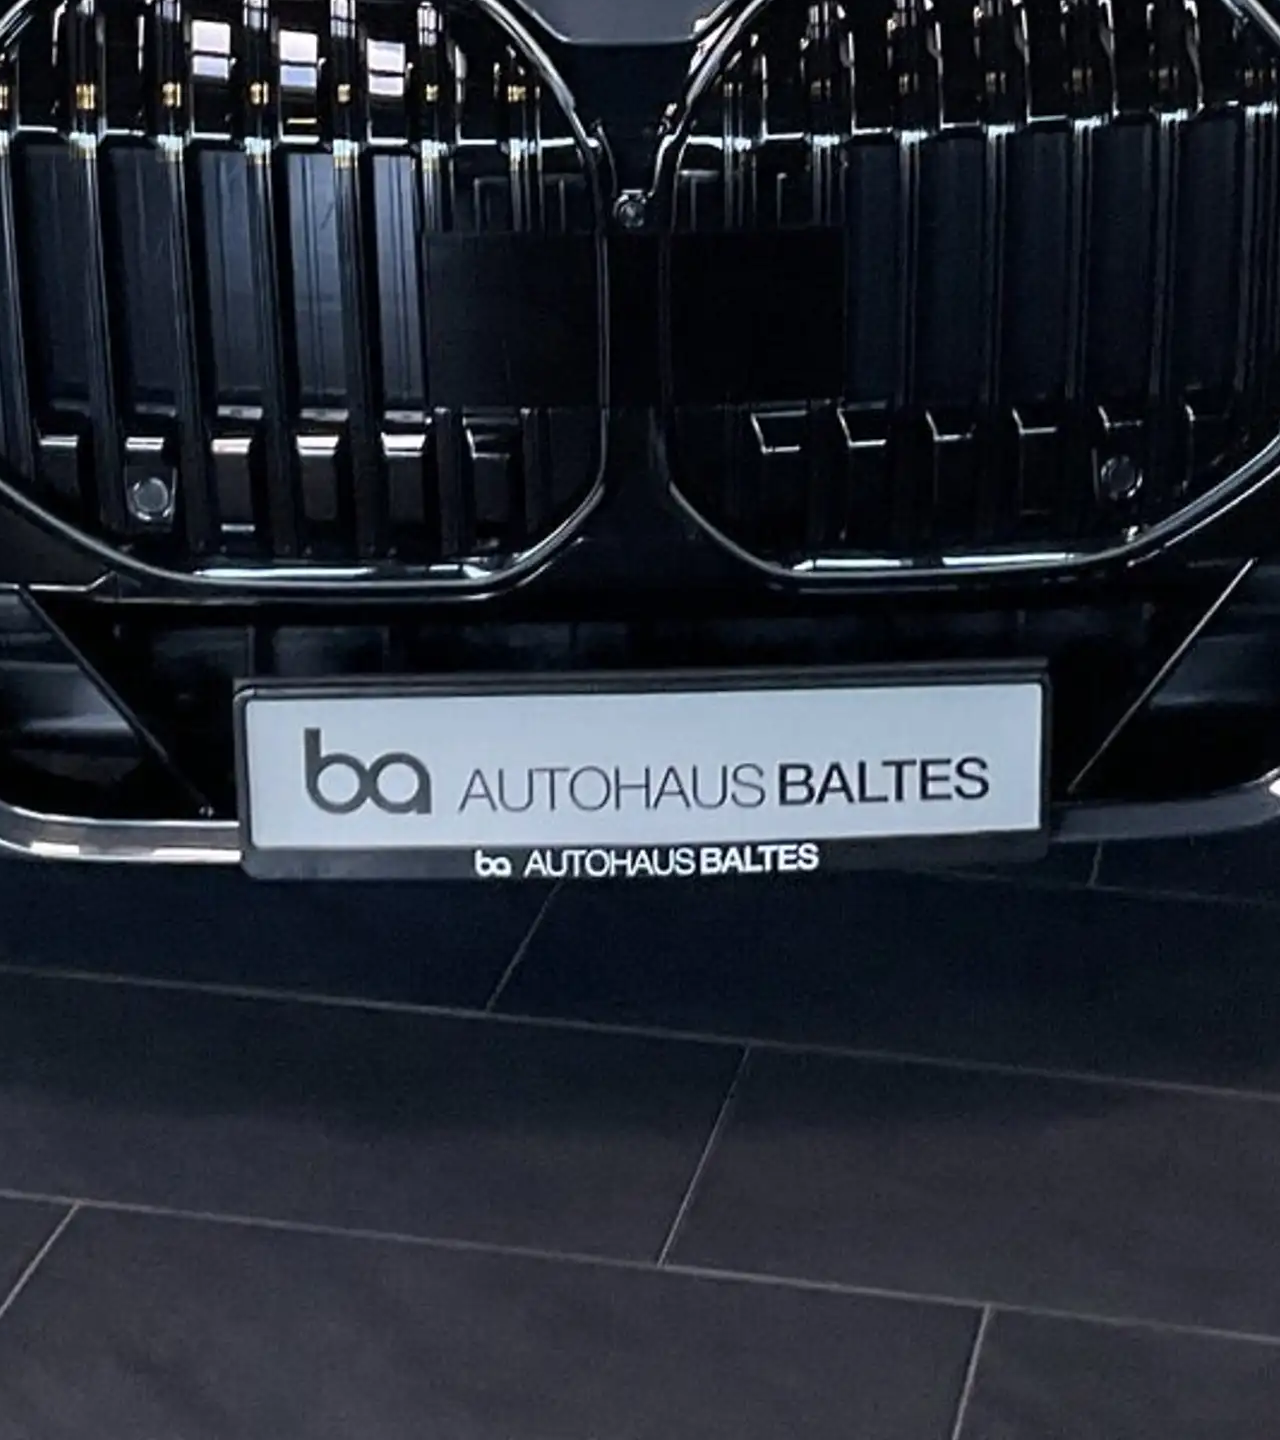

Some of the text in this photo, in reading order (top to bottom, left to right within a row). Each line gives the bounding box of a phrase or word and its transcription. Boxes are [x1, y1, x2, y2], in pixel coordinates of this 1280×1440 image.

[304, 728, 991, 815] ba AUTOHAUS BALTES
[474, 842, 819, 877] ba AUTOHAUS BALTES
